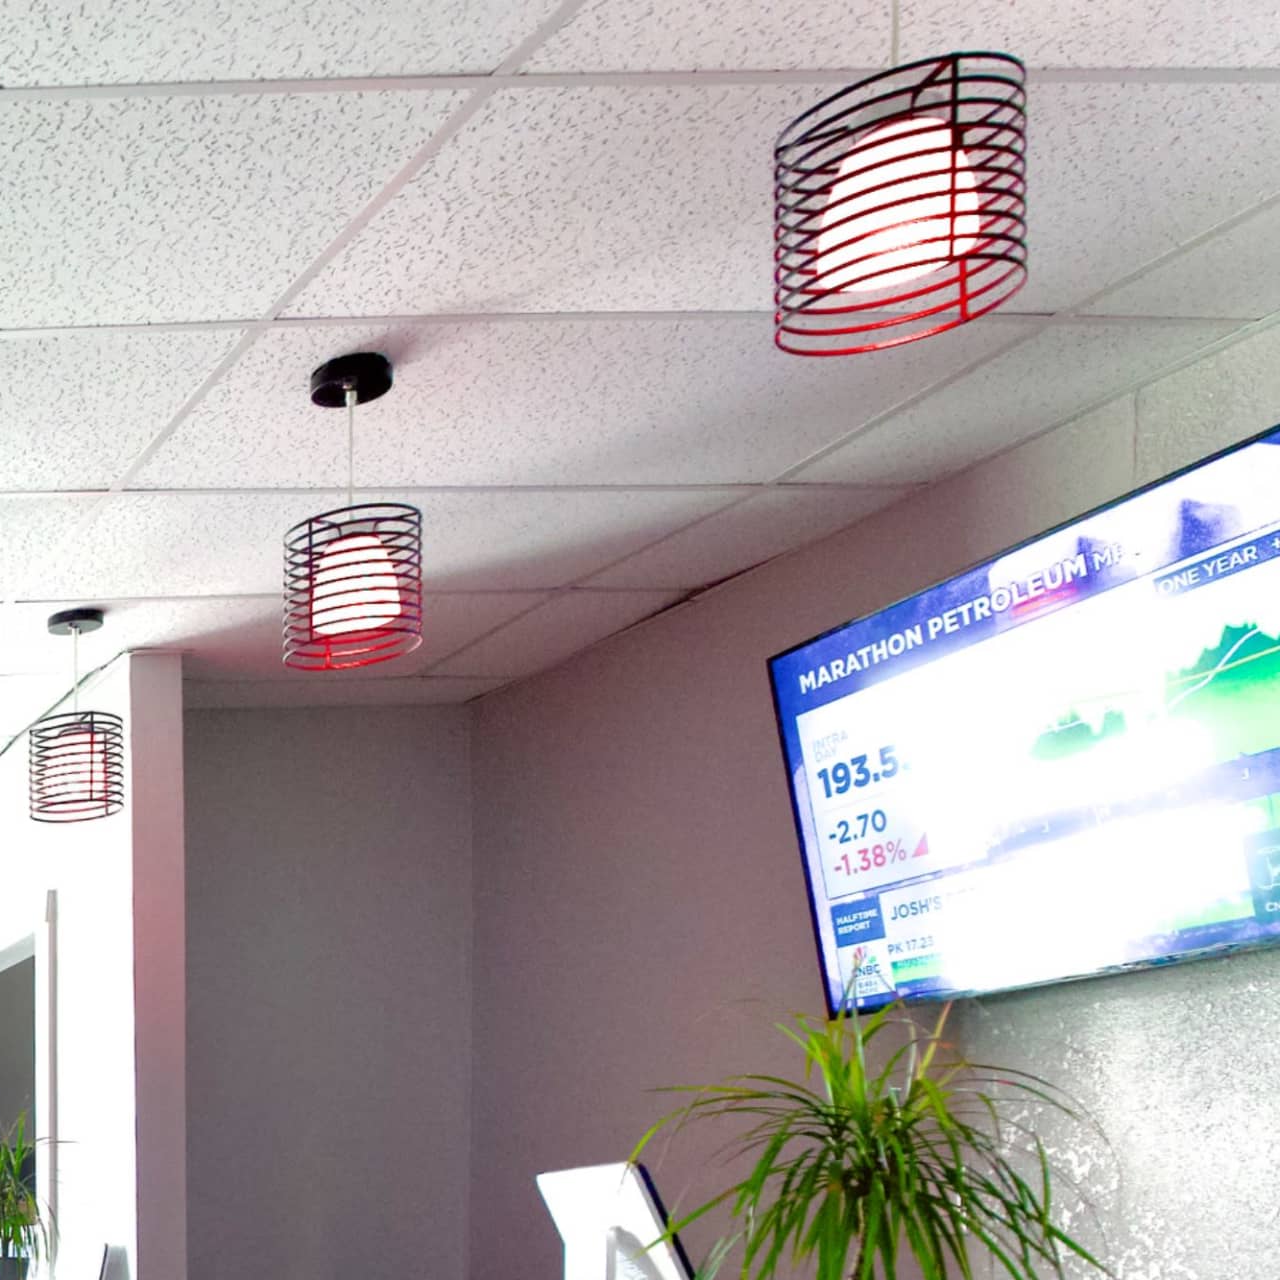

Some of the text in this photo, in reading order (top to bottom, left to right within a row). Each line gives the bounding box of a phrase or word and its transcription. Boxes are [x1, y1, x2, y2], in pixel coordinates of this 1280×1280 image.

[1159, 545, 1259, 595] ONE YEAR
[798, 624, 924, 694] MARATHON
[927, 553, 1095, 640] PETROLEUM
[816, 745, 902, 799] 193.5
[828, 809, 888, 844] -2.70
[834, 837, 908, 877] -1.38%
[836, 908, 879, 926] HALFTIME
[890, 895, 943, 921] JOSH'S
[837, 920, 872, 936] REPORT
